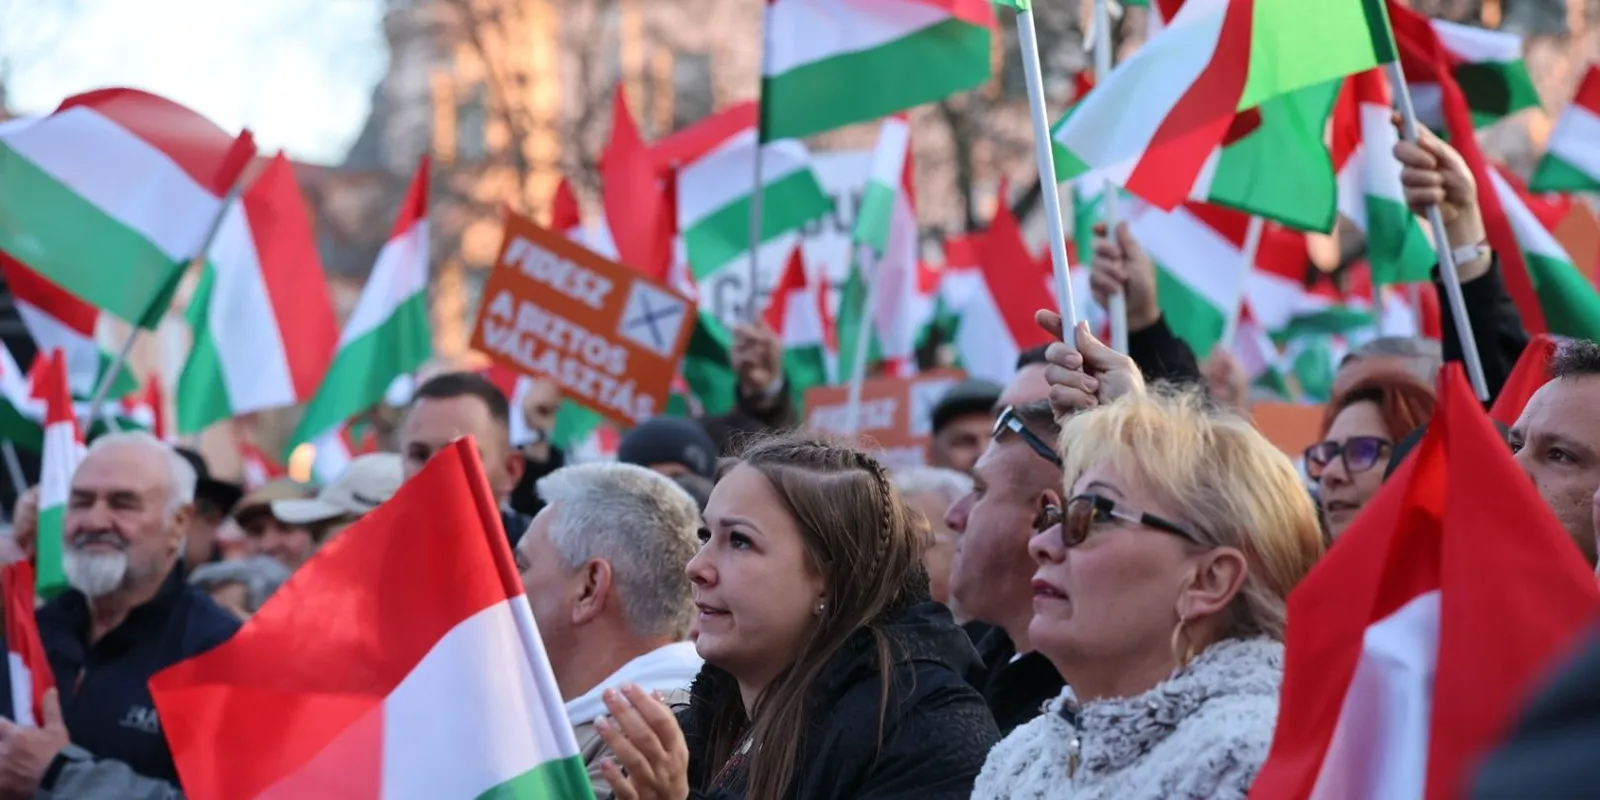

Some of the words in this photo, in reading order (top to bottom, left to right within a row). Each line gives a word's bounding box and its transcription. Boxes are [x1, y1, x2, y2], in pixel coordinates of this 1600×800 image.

[504, 235, 615, 310] FIDESZ
[483, 318, 655, 423] VÁLASZTÁS
[488, 289, 514, 324] A
[516, 300, 629, 376] BIZTOS
